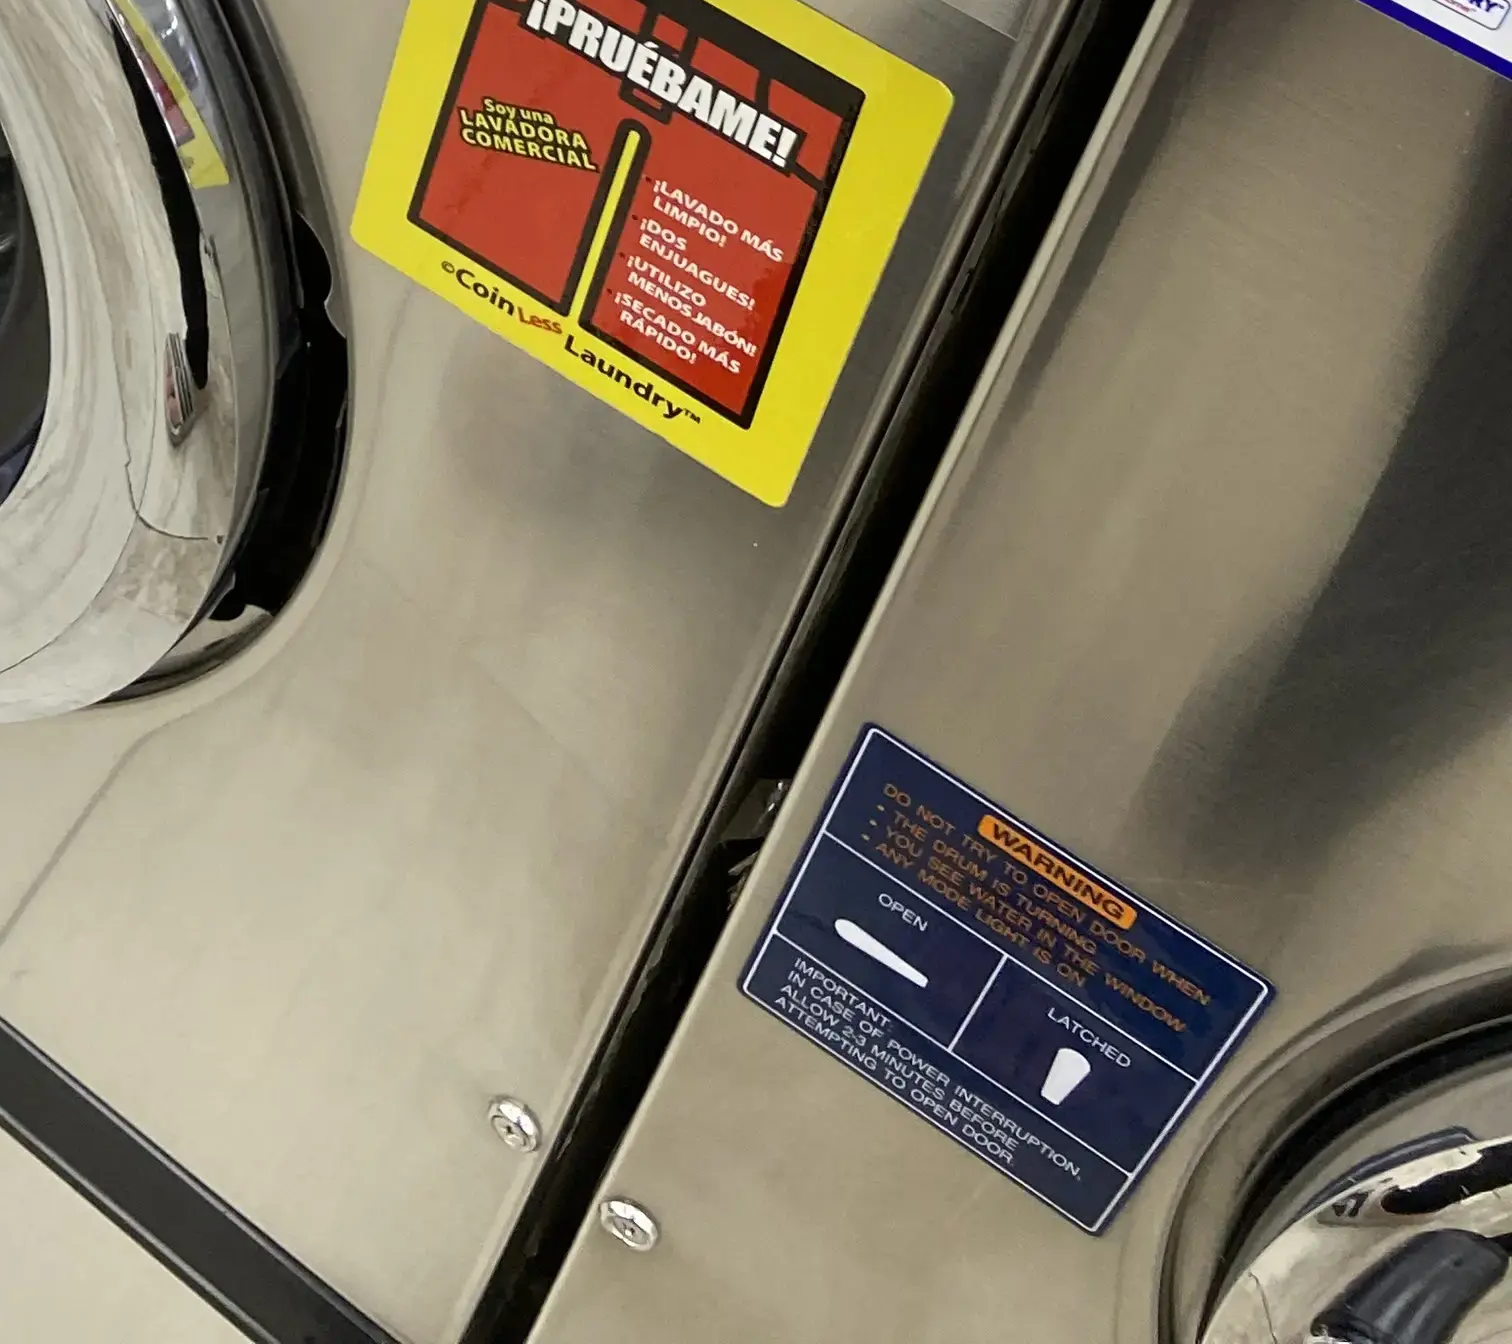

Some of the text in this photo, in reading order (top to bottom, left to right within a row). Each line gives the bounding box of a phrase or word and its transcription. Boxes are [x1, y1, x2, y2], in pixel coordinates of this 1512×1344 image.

[459, 108, 588, 151] LAVADORA
[483, 97, 555, 125] Soy una
[461, 127, 597, 171] COMERCIAL
[639, 217, 688, 252] ¡DOS
[652, 179, 785, 263] ¡LAVADO MÁS
[652, 195, 728, 248] LIMPIO!
[625, 254, 708, 308] ¡UTILIZO
[639, 232, 756, 312] ENJUAGUES!
[613, 291, 742, 375] ¡SECADO MÁS
[618, 309, 698, 366] RÁPIDO!
[627, 270, 758, 358] MENOS JABÓN!
[992, 822, 1126, 921] WARNING
[877, 892, 930, 933] OPEN
[1046, 1006, 1132, 1069] LATCHED
[773, 996, 1016, 1168] ATTEMPTING TO OPEN DOOR.
[779, 984, 1021, 1152] ALLOW 2-3 MINUTES BEFORE
